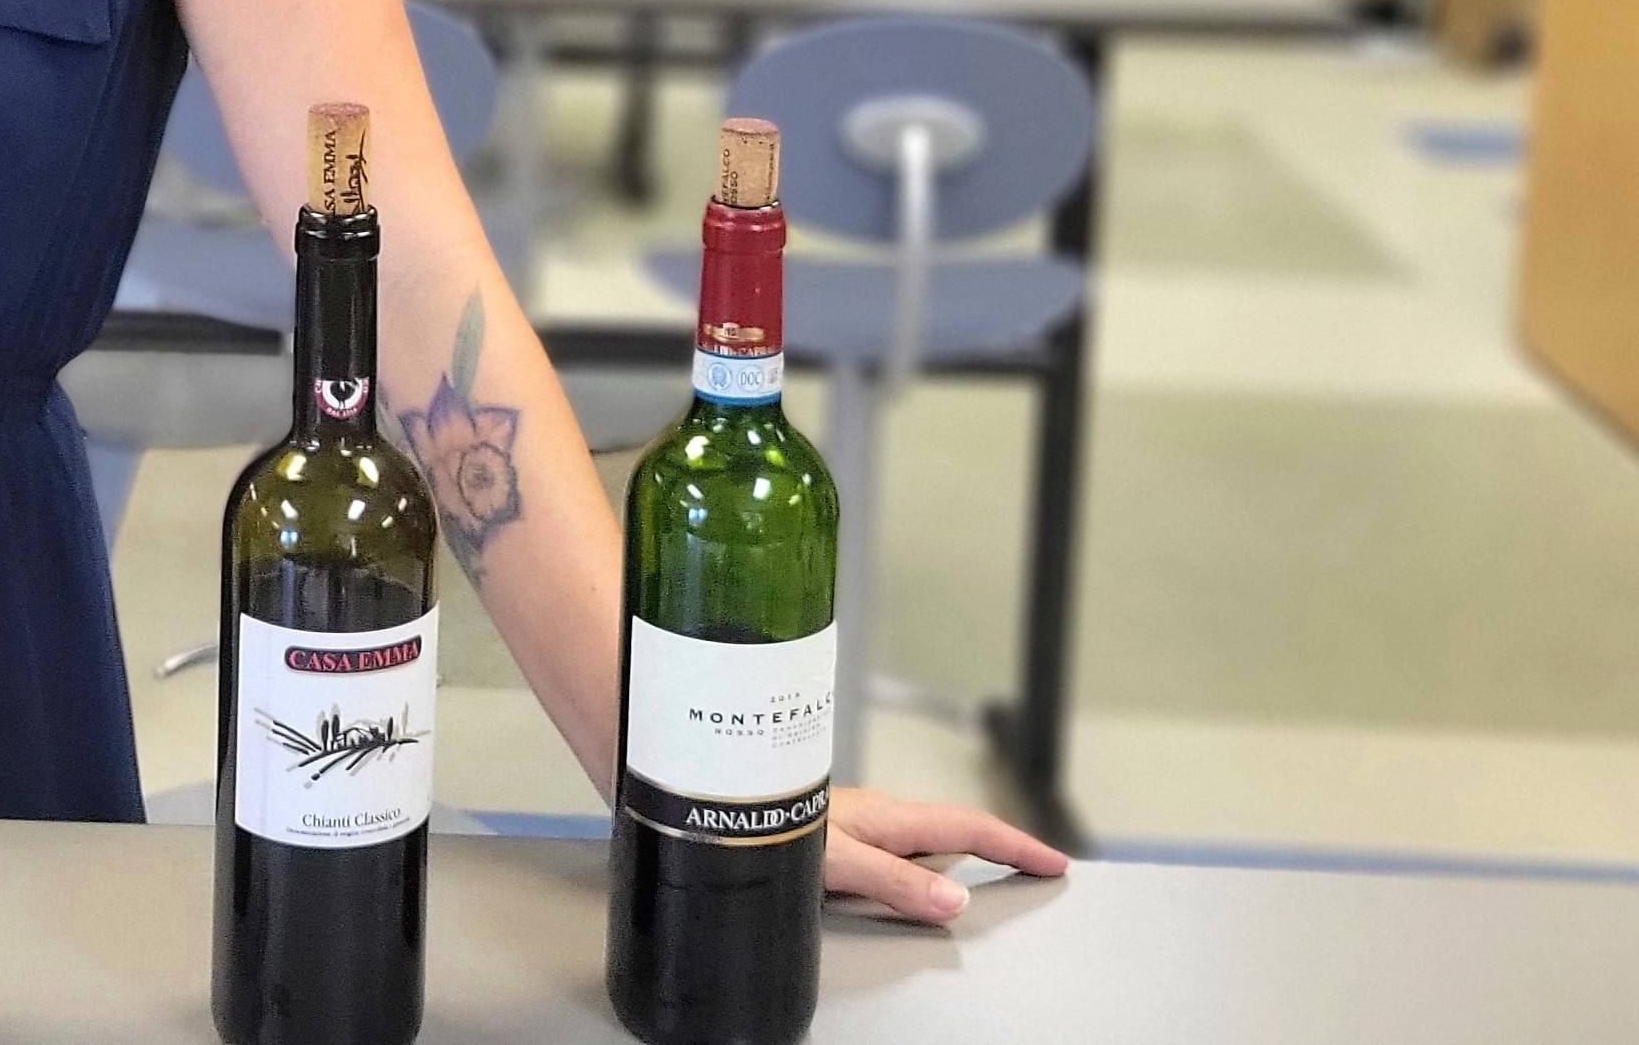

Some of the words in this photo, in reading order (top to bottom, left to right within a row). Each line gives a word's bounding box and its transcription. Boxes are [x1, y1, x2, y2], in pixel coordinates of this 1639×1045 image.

[324, 130, 336, 184] EMMA
[288, 650, 352, 671] CASA
[357, 640, 419, 670] EMMA
[302, 813, 351, 828] Chianti
[354, 808, 401, 827] Classico
